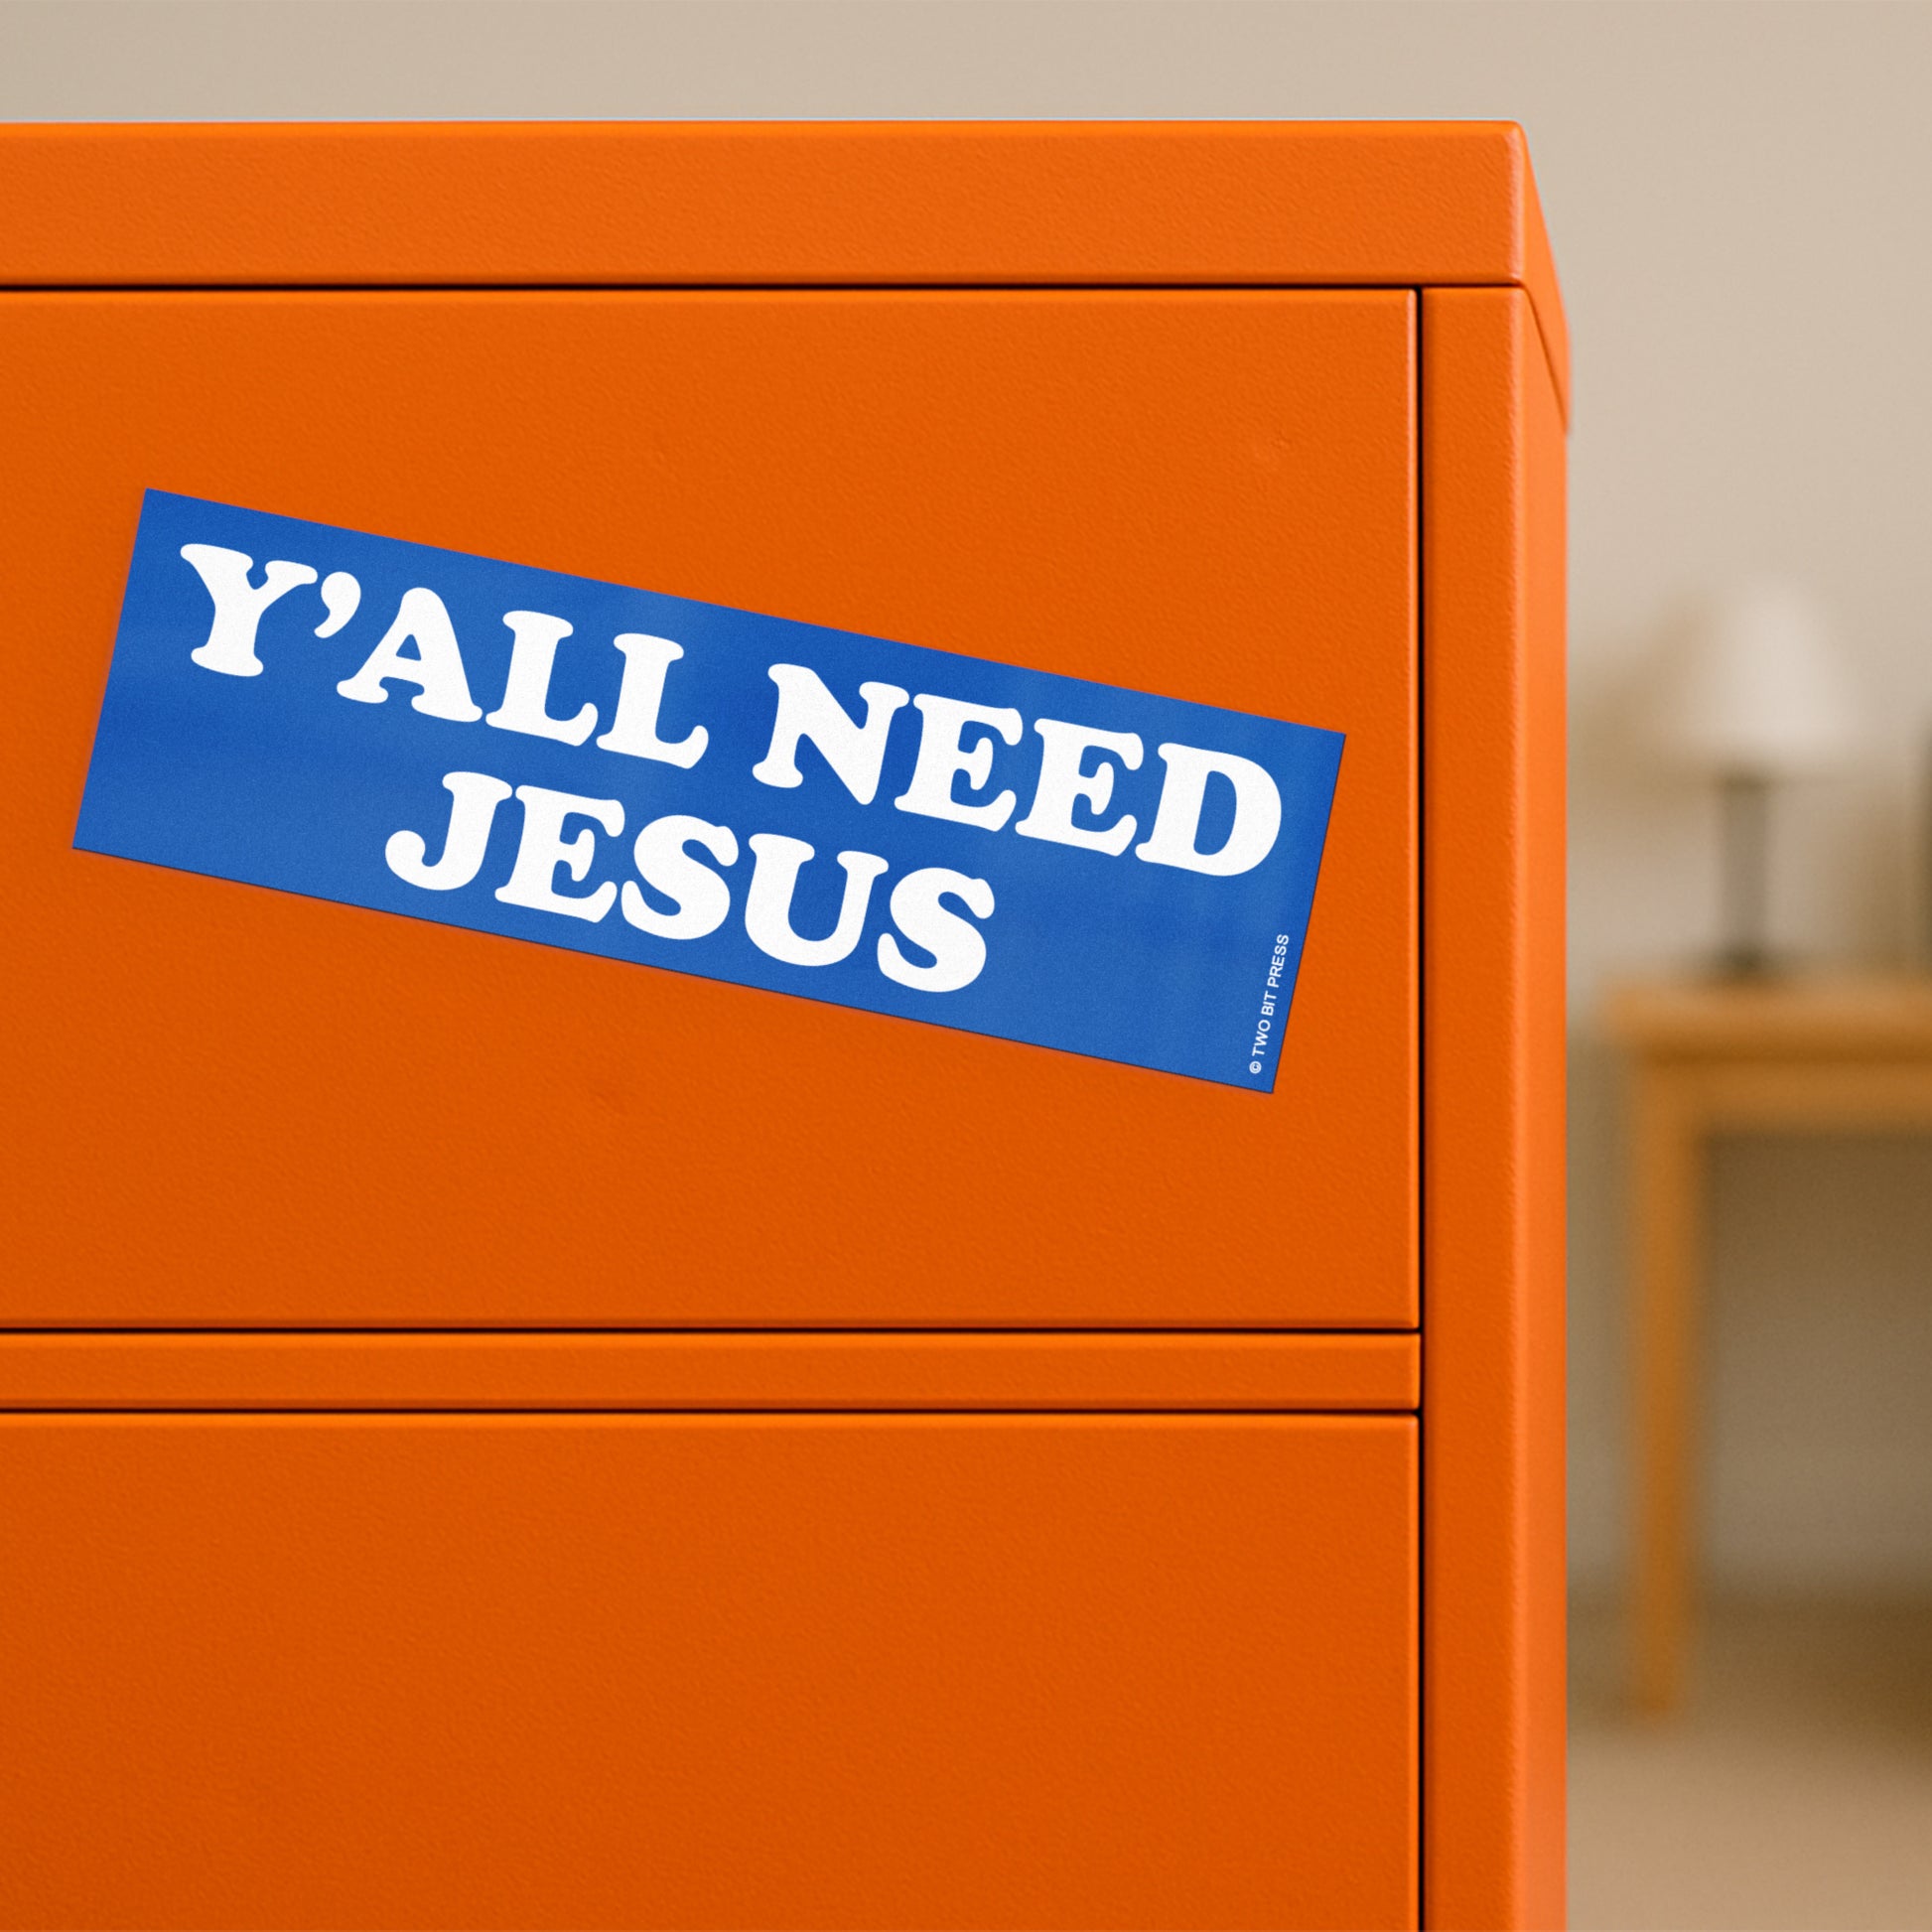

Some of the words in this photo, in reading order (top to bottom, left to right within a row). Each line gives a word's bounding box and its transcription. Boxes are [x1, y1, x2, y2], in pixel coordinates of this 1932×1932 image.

[180, 543, 710, 769] Y’ALL
[752, 663, 1282, 877] NEED
[384, 770, 996, 993] JESUS
[1267, 934, 1290, 988] PRESS
[1260, 990, 1277, 1017] BIT
[1252, 1019, 1271, 1056] TWO
[1249, 1060, 1262, 1074] ©
